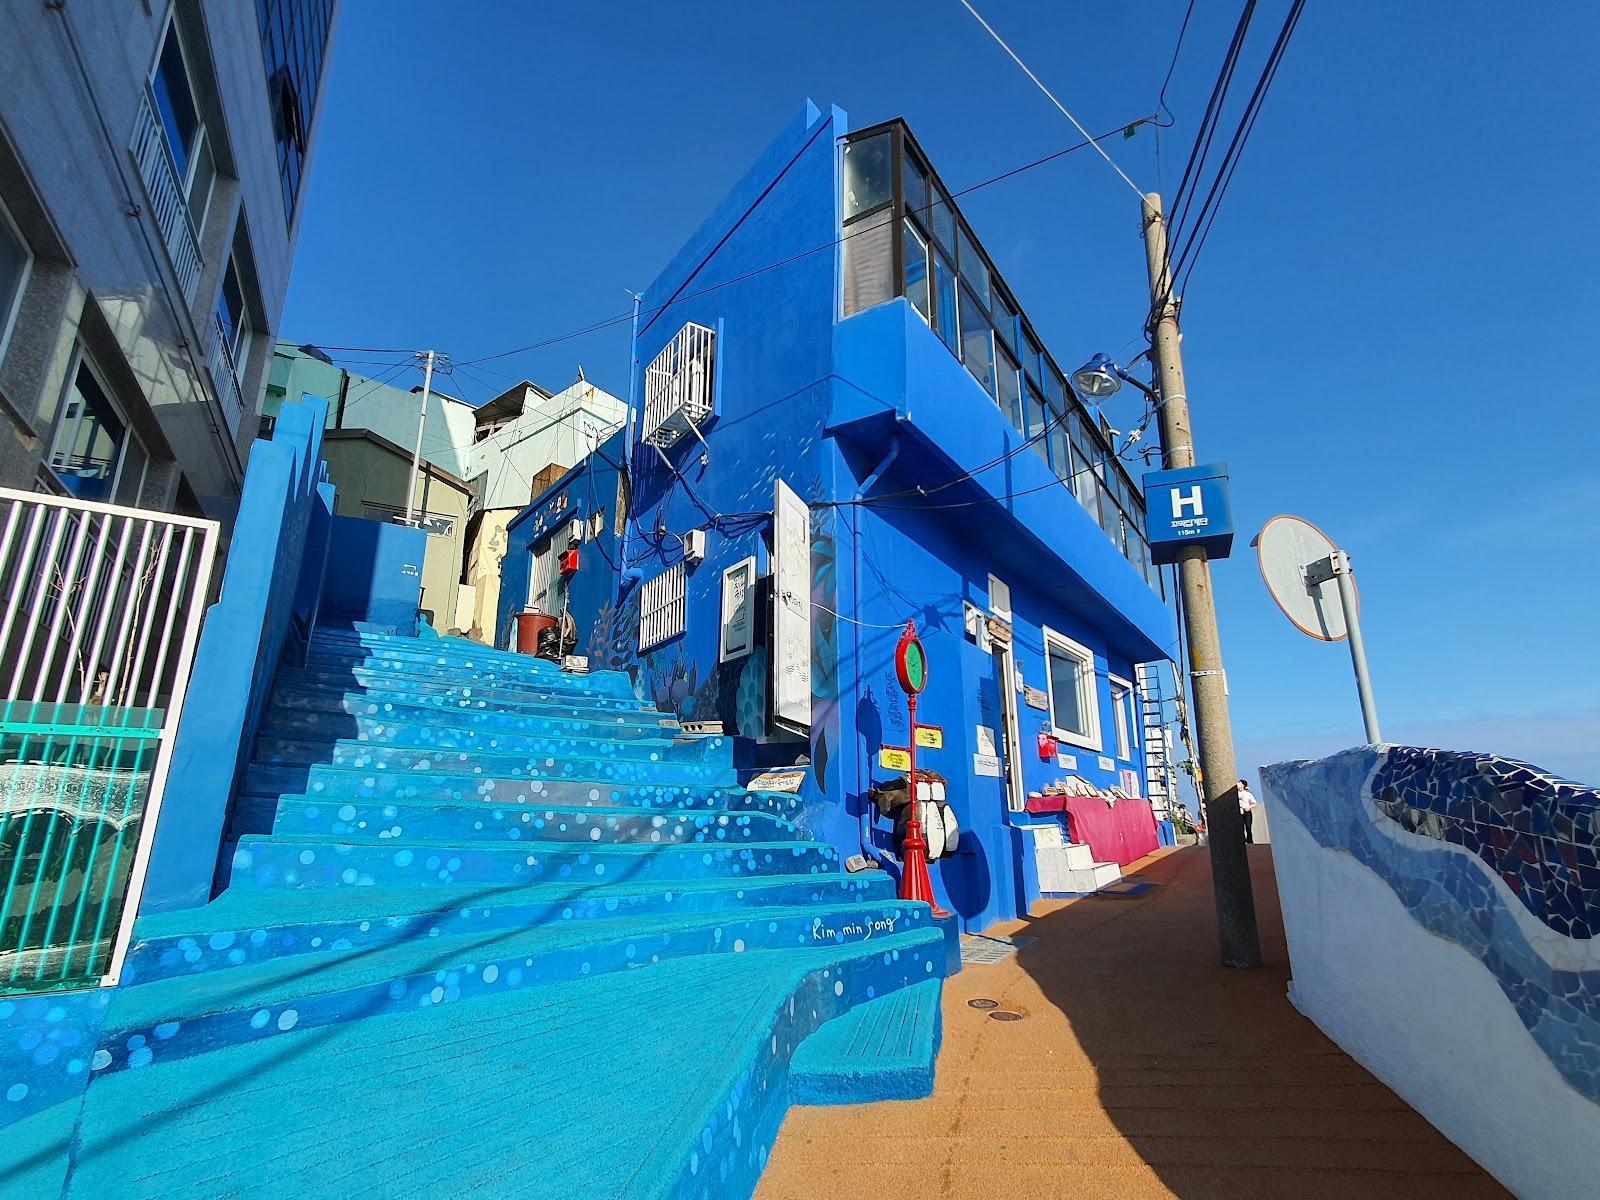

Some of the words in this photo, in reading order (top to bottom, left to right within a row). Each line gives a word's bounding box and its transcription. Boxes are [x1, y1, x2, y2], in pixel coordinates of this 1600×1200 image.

[1170, 485, 1204, 519] H
[812, 922, 836, 940] Kim
[842, 922, 863, 936] min
